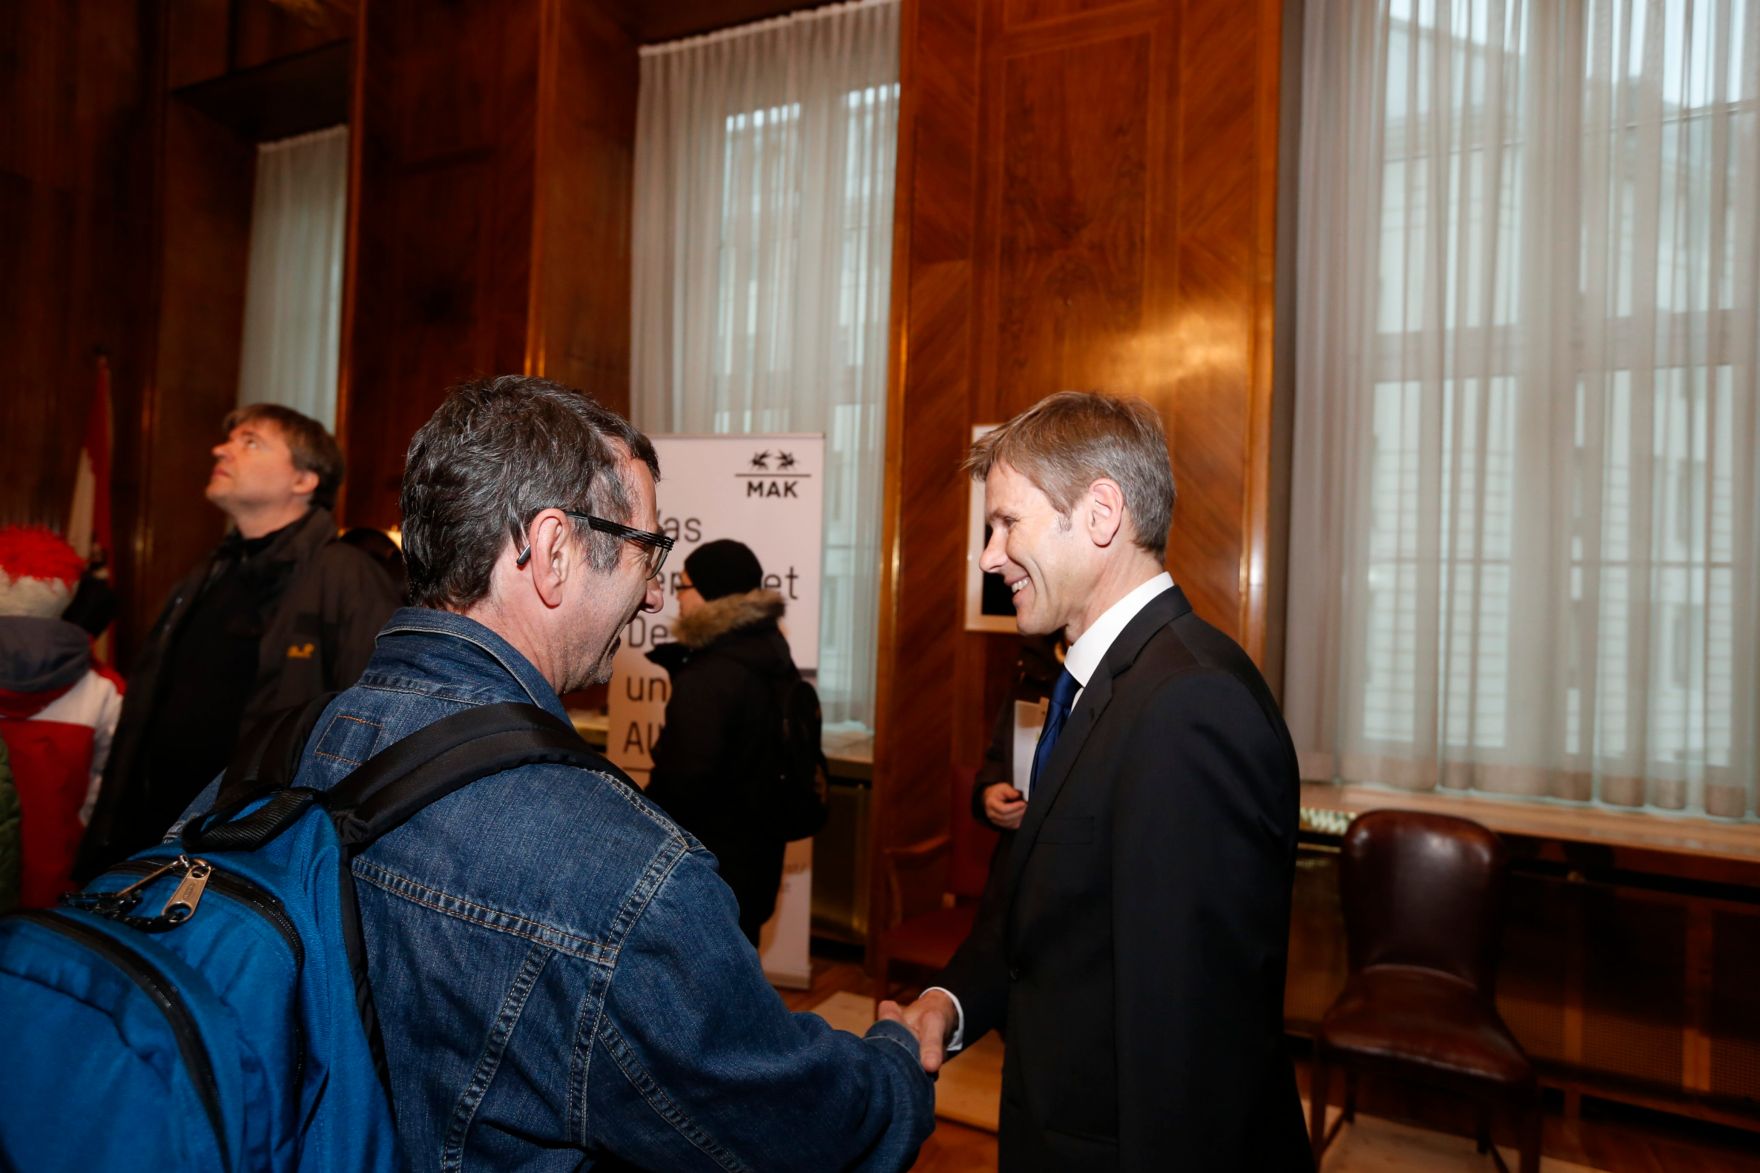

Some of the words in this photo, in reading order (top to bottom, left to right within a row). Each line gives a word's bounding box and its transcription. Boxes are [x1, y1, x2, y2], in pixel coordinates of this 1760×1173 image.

[747, 481, 798, 498] MAK
[657, 509, 702, 543] as
[628, 615, 668, 647] De
[626, 676, 667, 702] un
